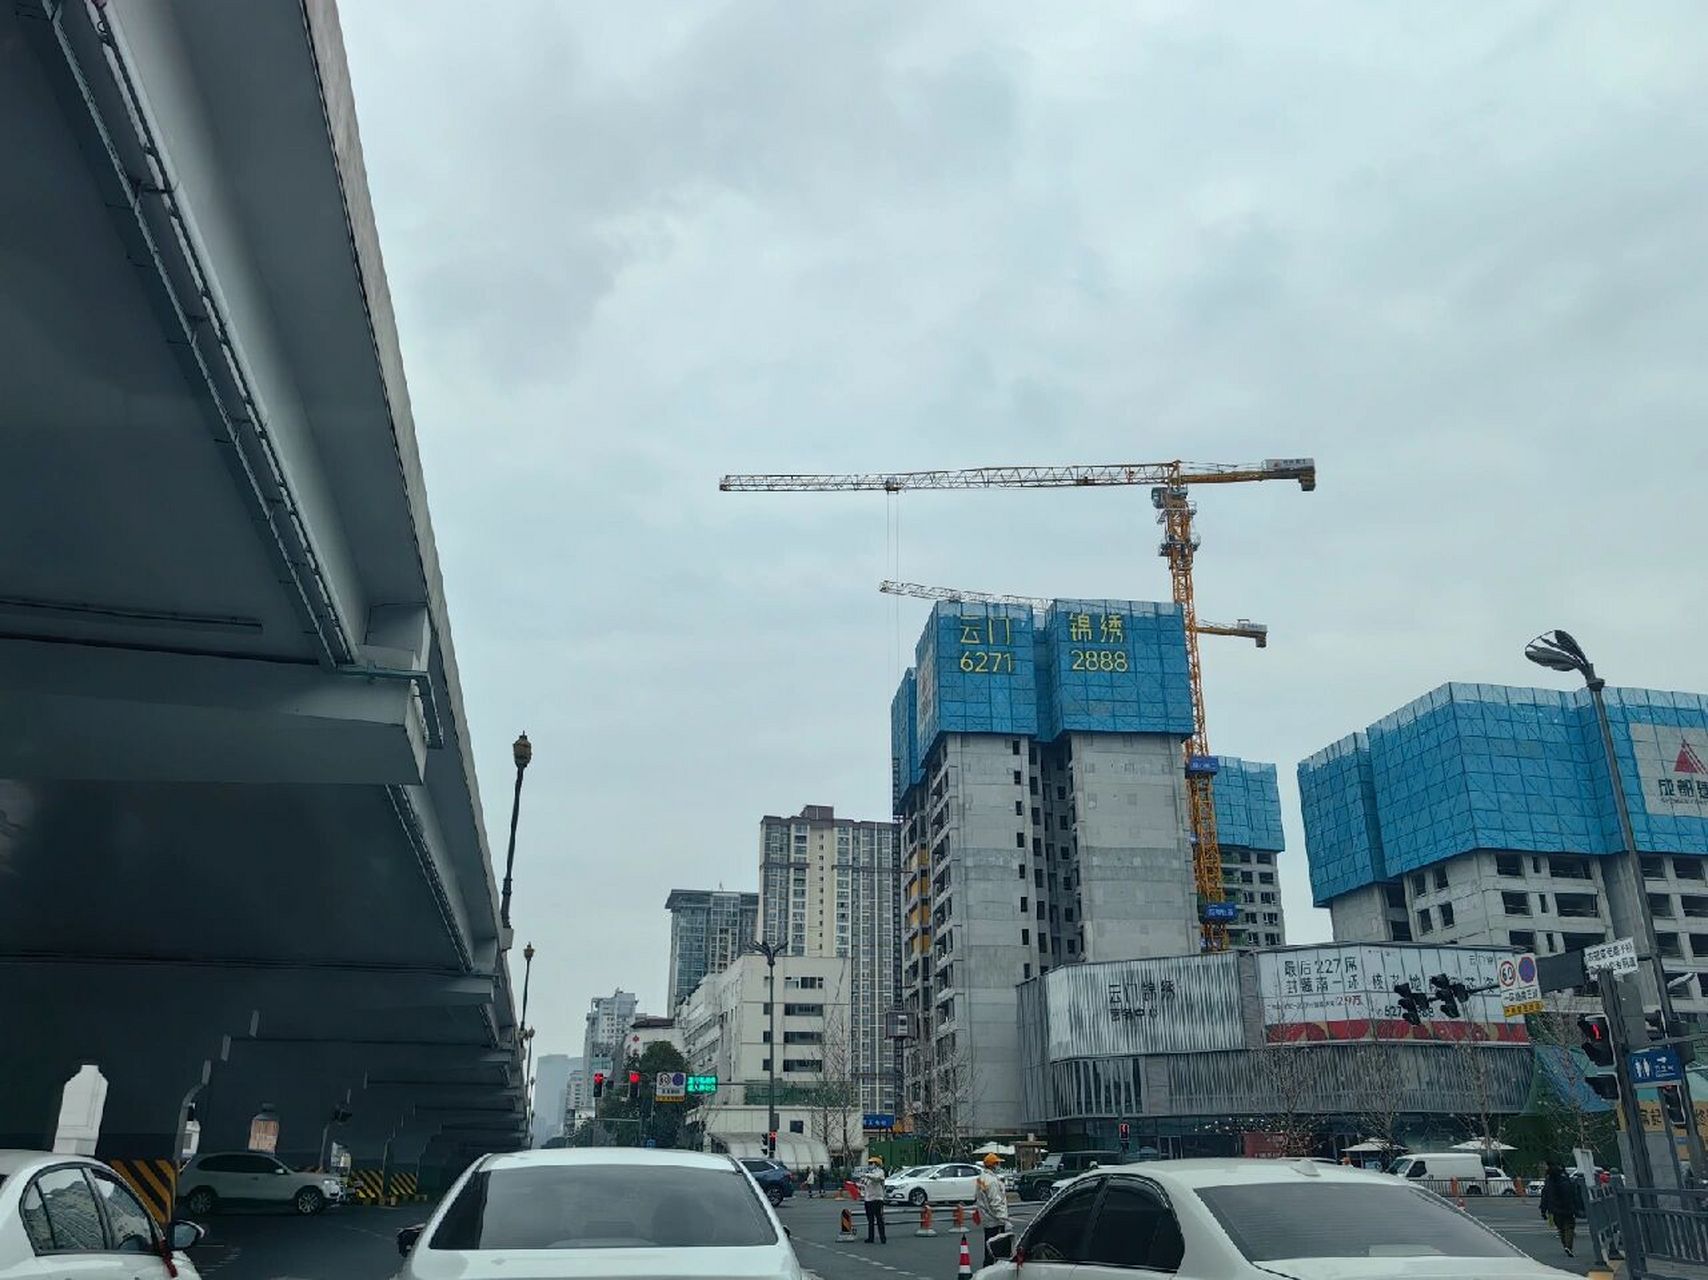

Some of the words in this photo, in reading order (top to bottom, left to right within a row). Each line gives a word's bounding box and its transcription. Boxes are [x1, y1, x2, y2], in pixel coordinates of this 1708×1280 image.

[960, 614, 1011, 645] 云门
[1069, 612, 1124, 643] 锦绣
[960, 651, 1014, 673] 6271
[1071, 650, 1129, 672] 2888
